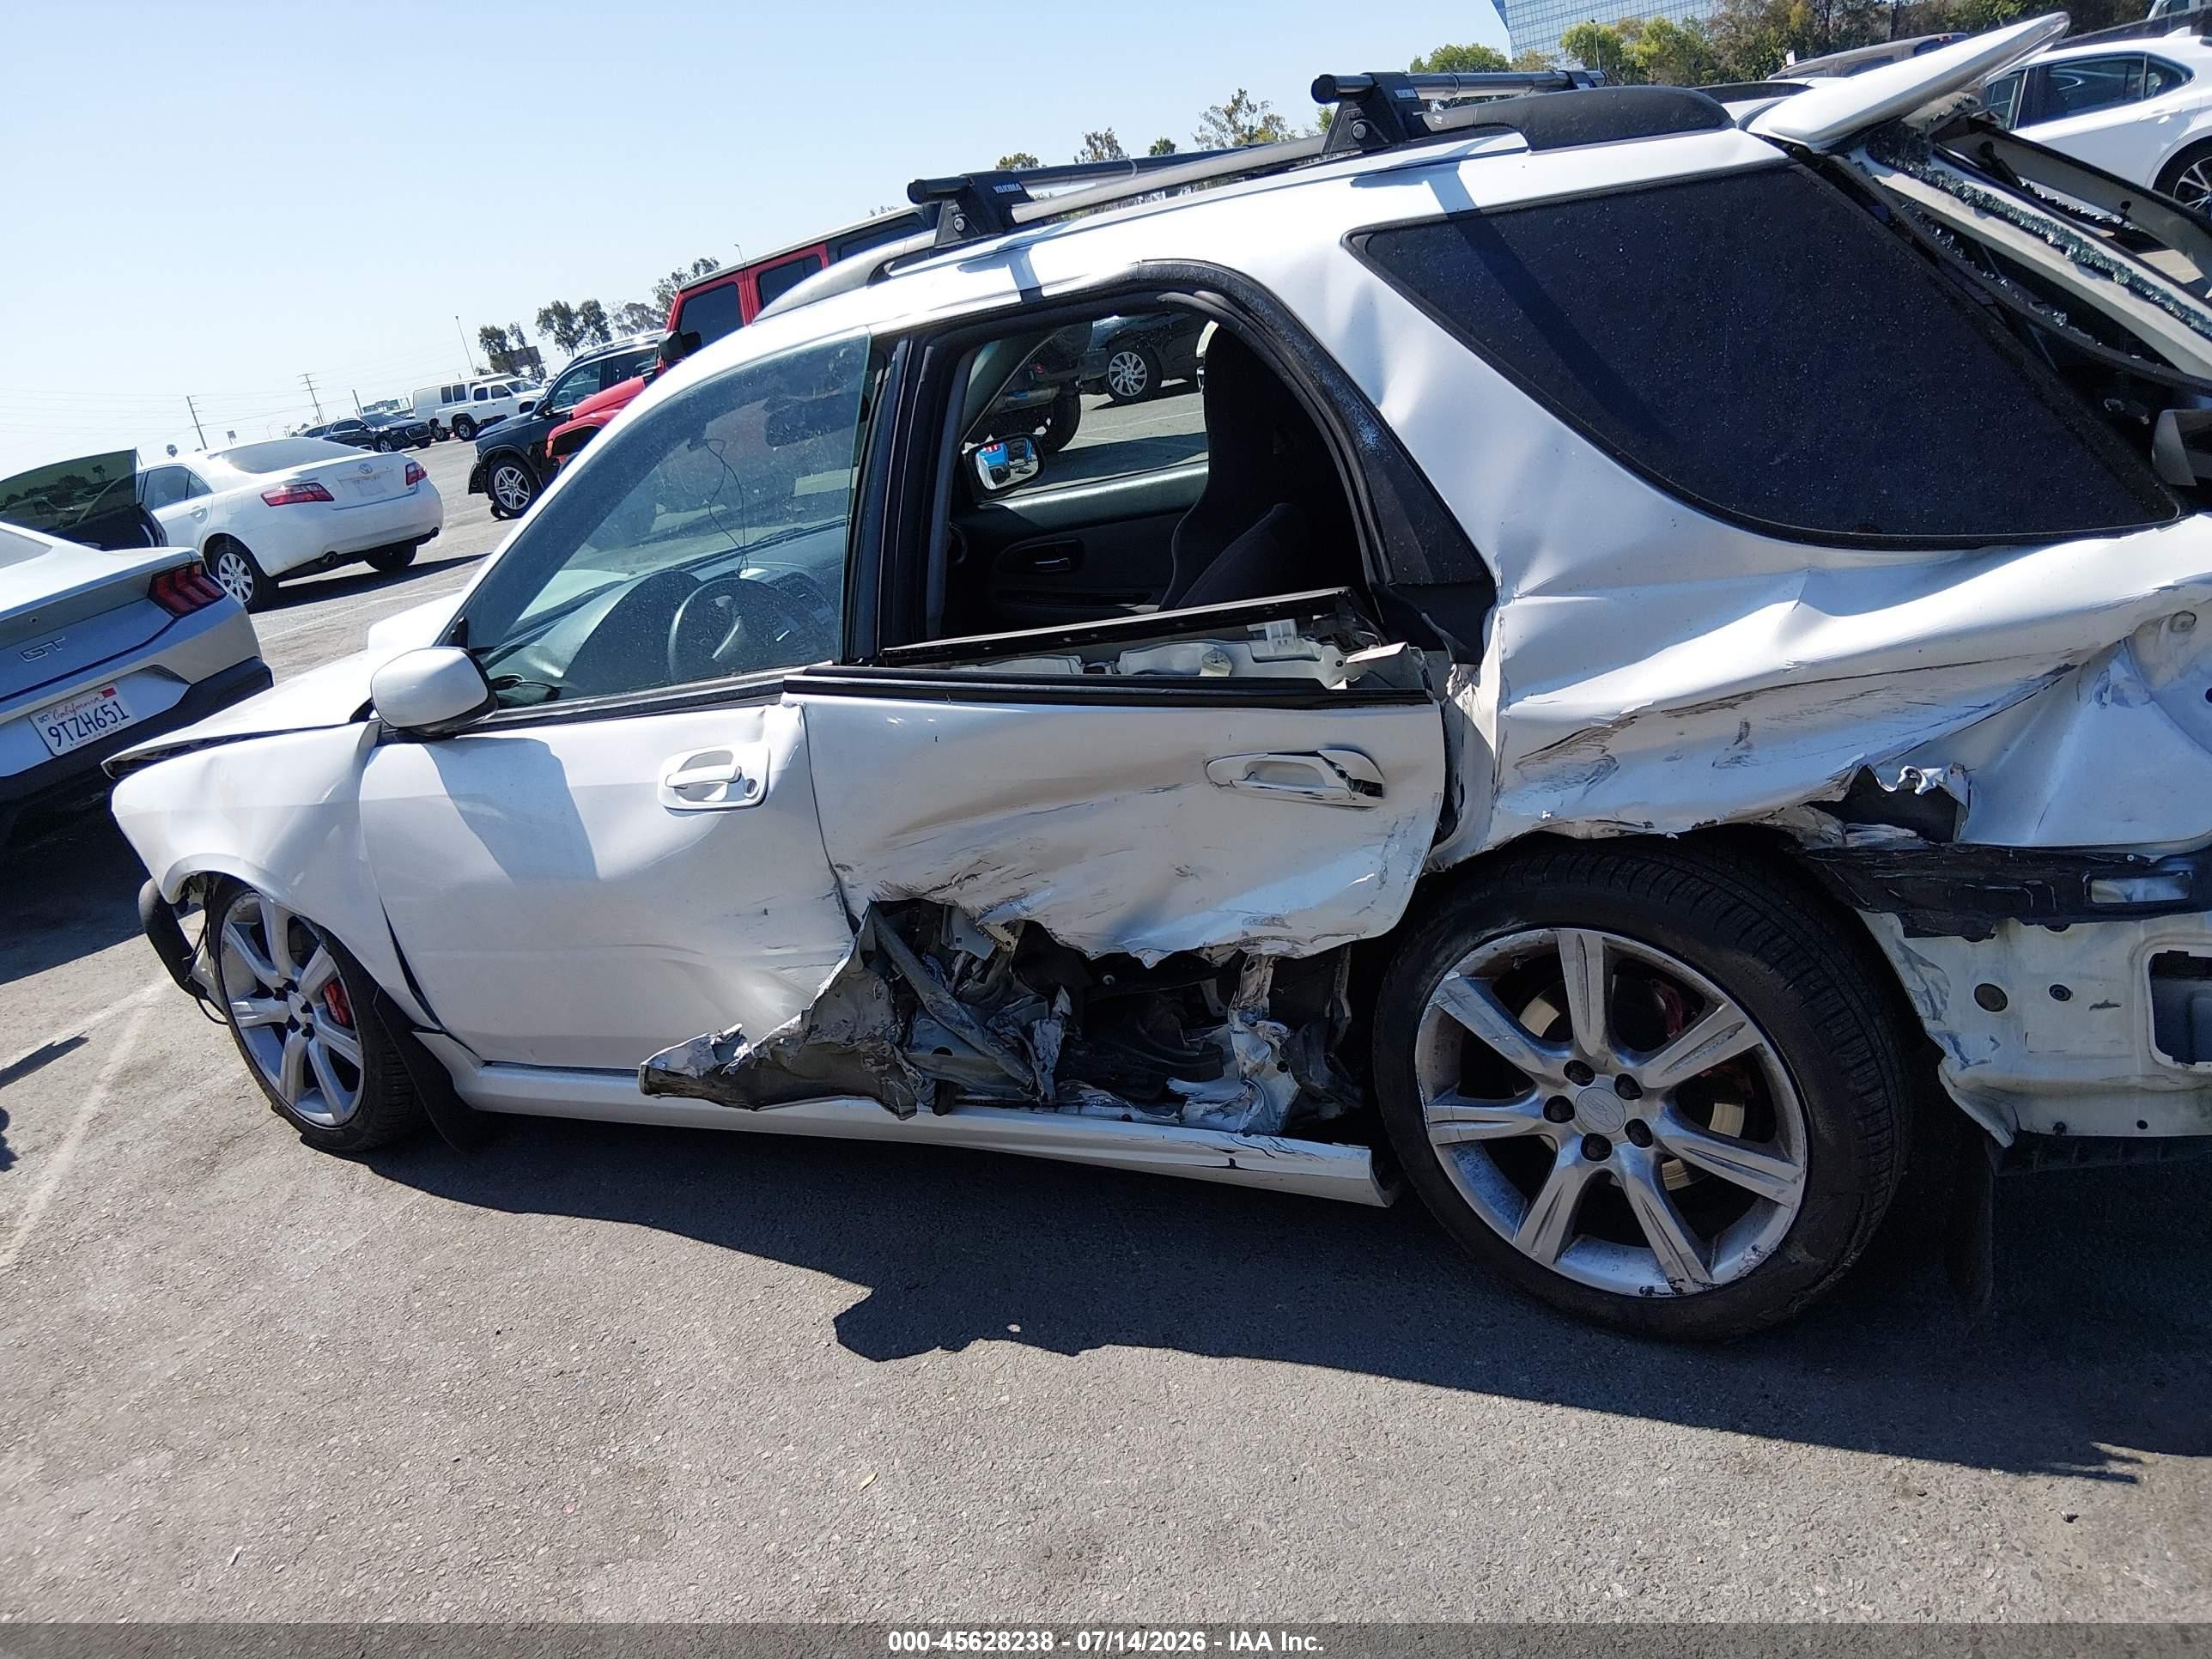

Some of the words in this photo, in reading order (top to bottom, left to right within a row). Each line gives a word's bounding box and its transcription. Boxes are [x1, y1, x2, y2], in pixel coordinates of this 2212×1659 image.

[993, 183, 1022, 193] YAKIMA
[19, 637, 65, 662] GT
[52, 696, 105, 720] California
[47, 700, 130, 748] 9TZH651
